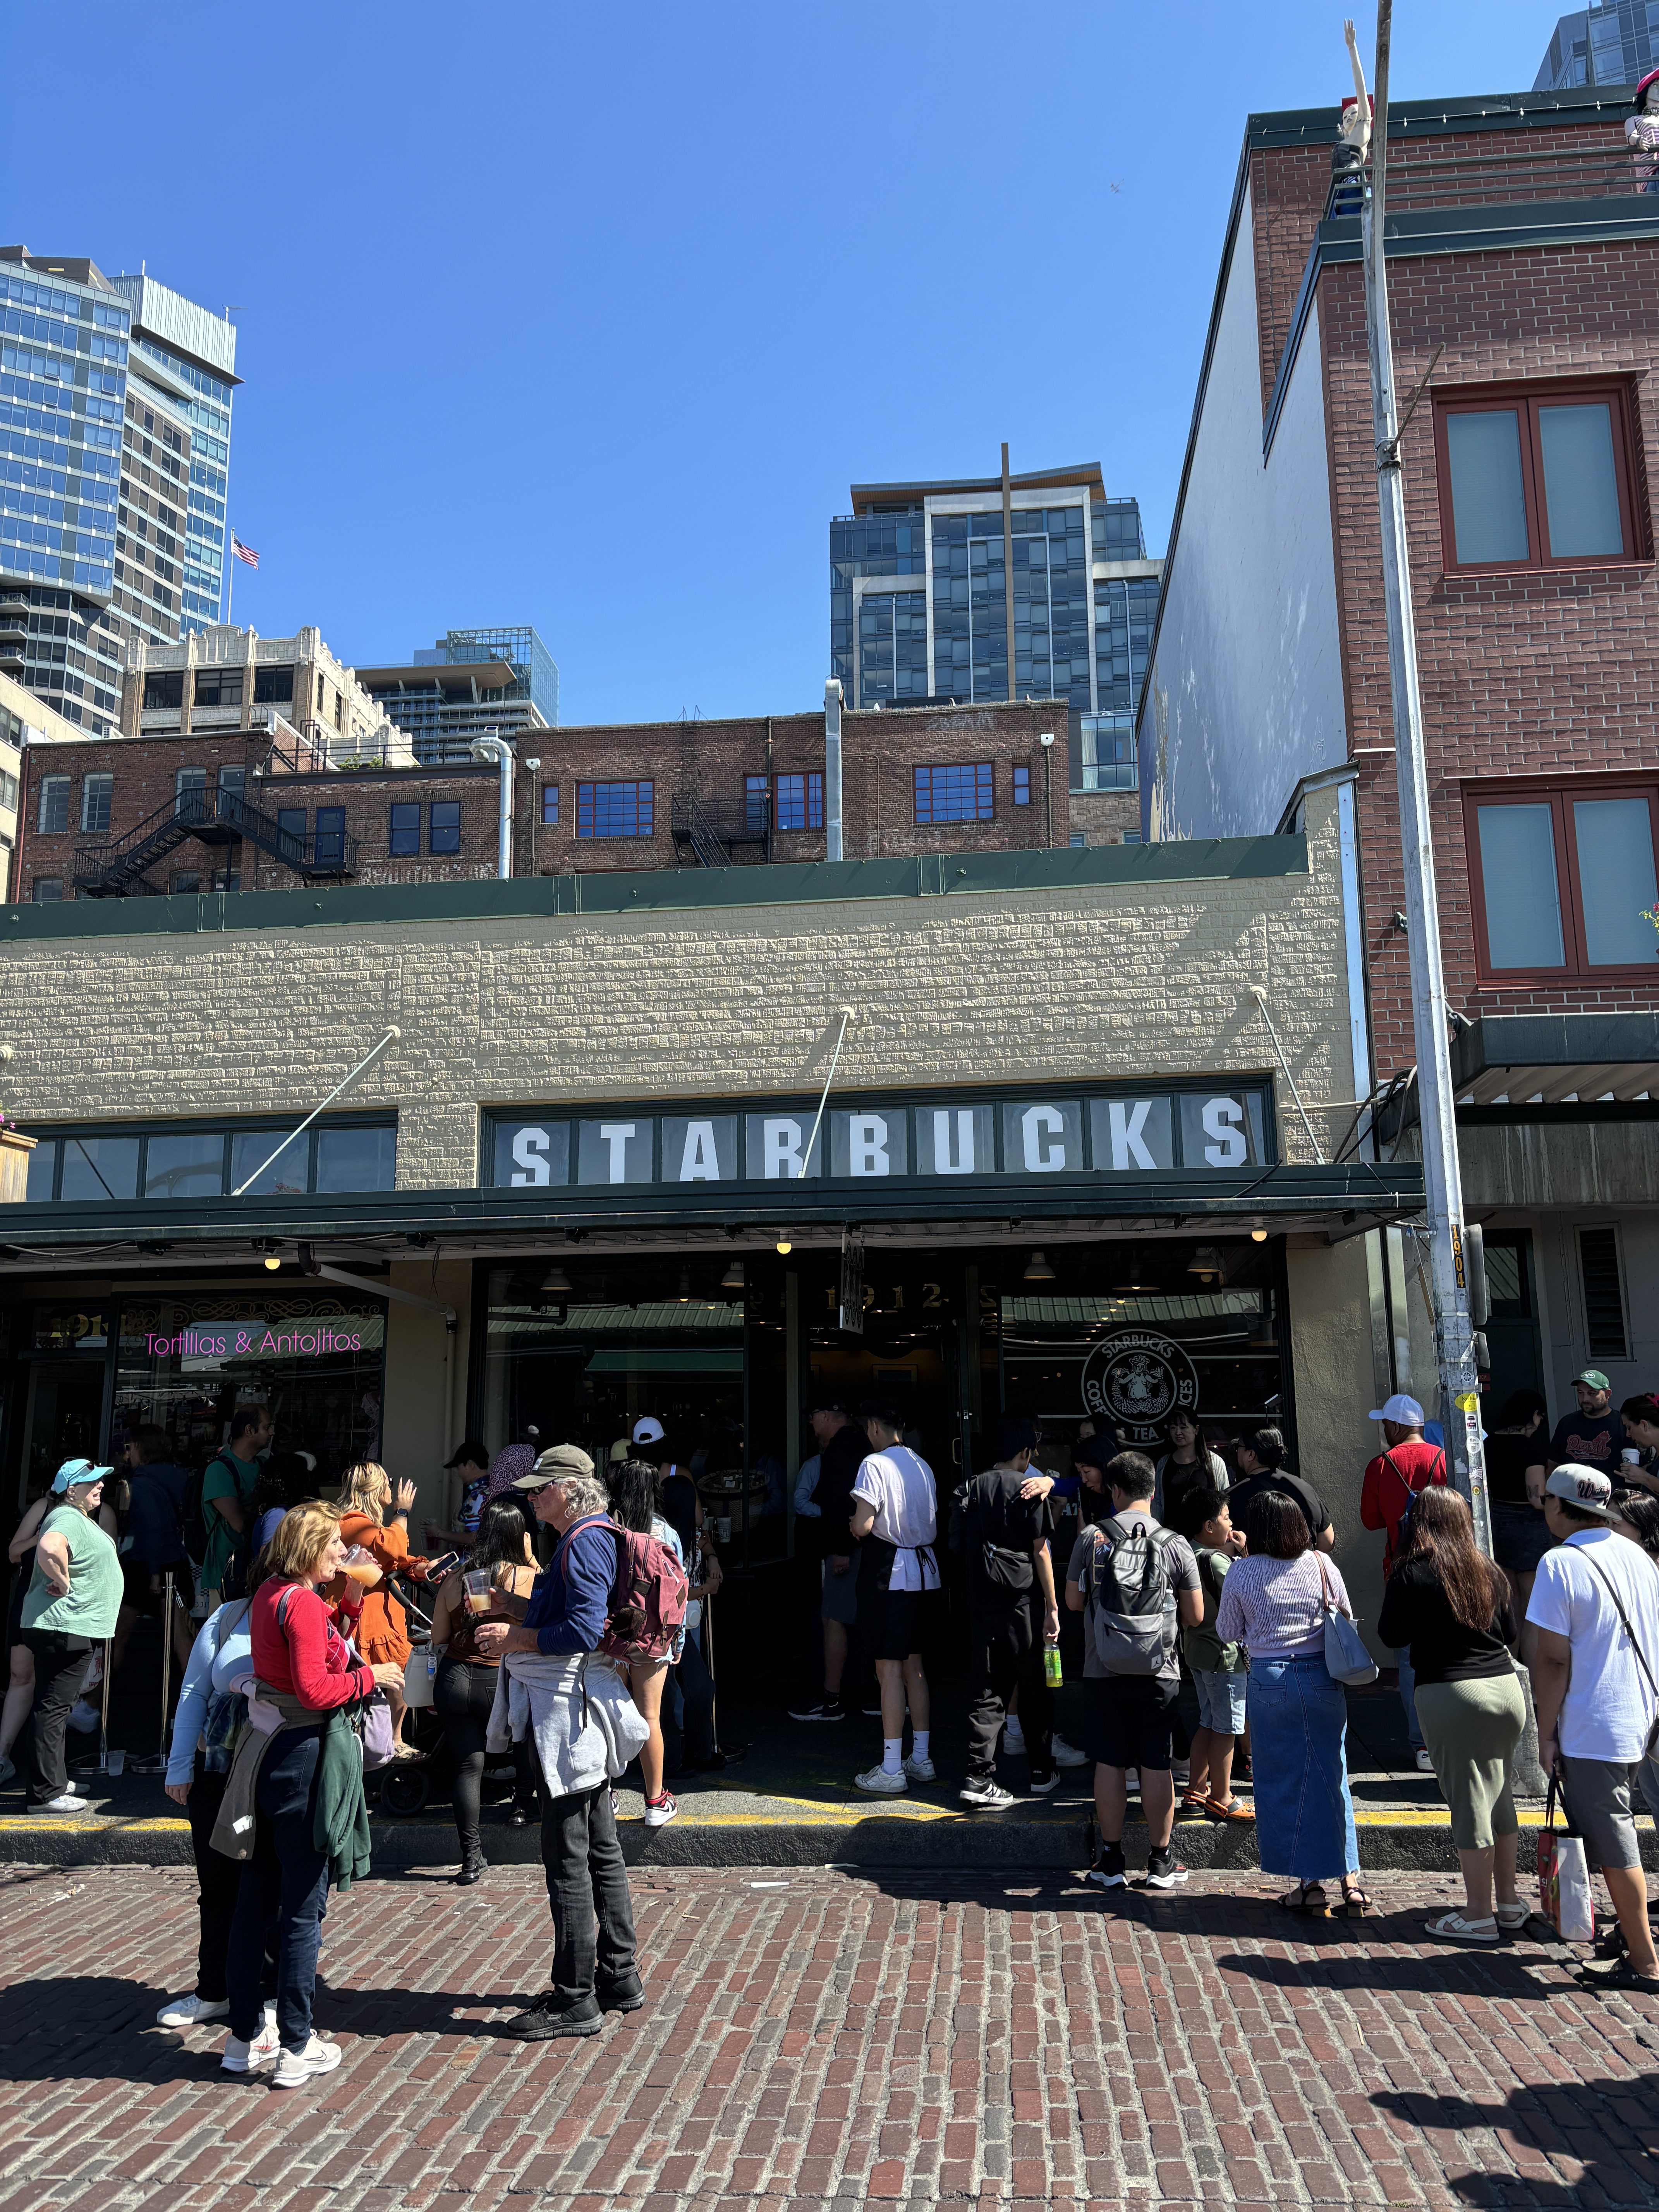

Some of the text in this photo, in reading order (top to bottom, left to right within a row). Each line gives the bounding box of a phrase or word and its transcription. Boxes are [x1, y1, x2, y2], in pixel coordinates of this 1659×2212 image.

[511, 1097, 1247, 1187] STARBUCKS
[1451, 1224, 1465, 1288] 1904
[144, 1328, 361, 1357] Tortillas & Antojitos
[1101, 1334, 1175, 1358] STARBUCKS
[1087, 1380, 1117, 1421] COFF
[1133, 1427, 1159, 1440] TEA
